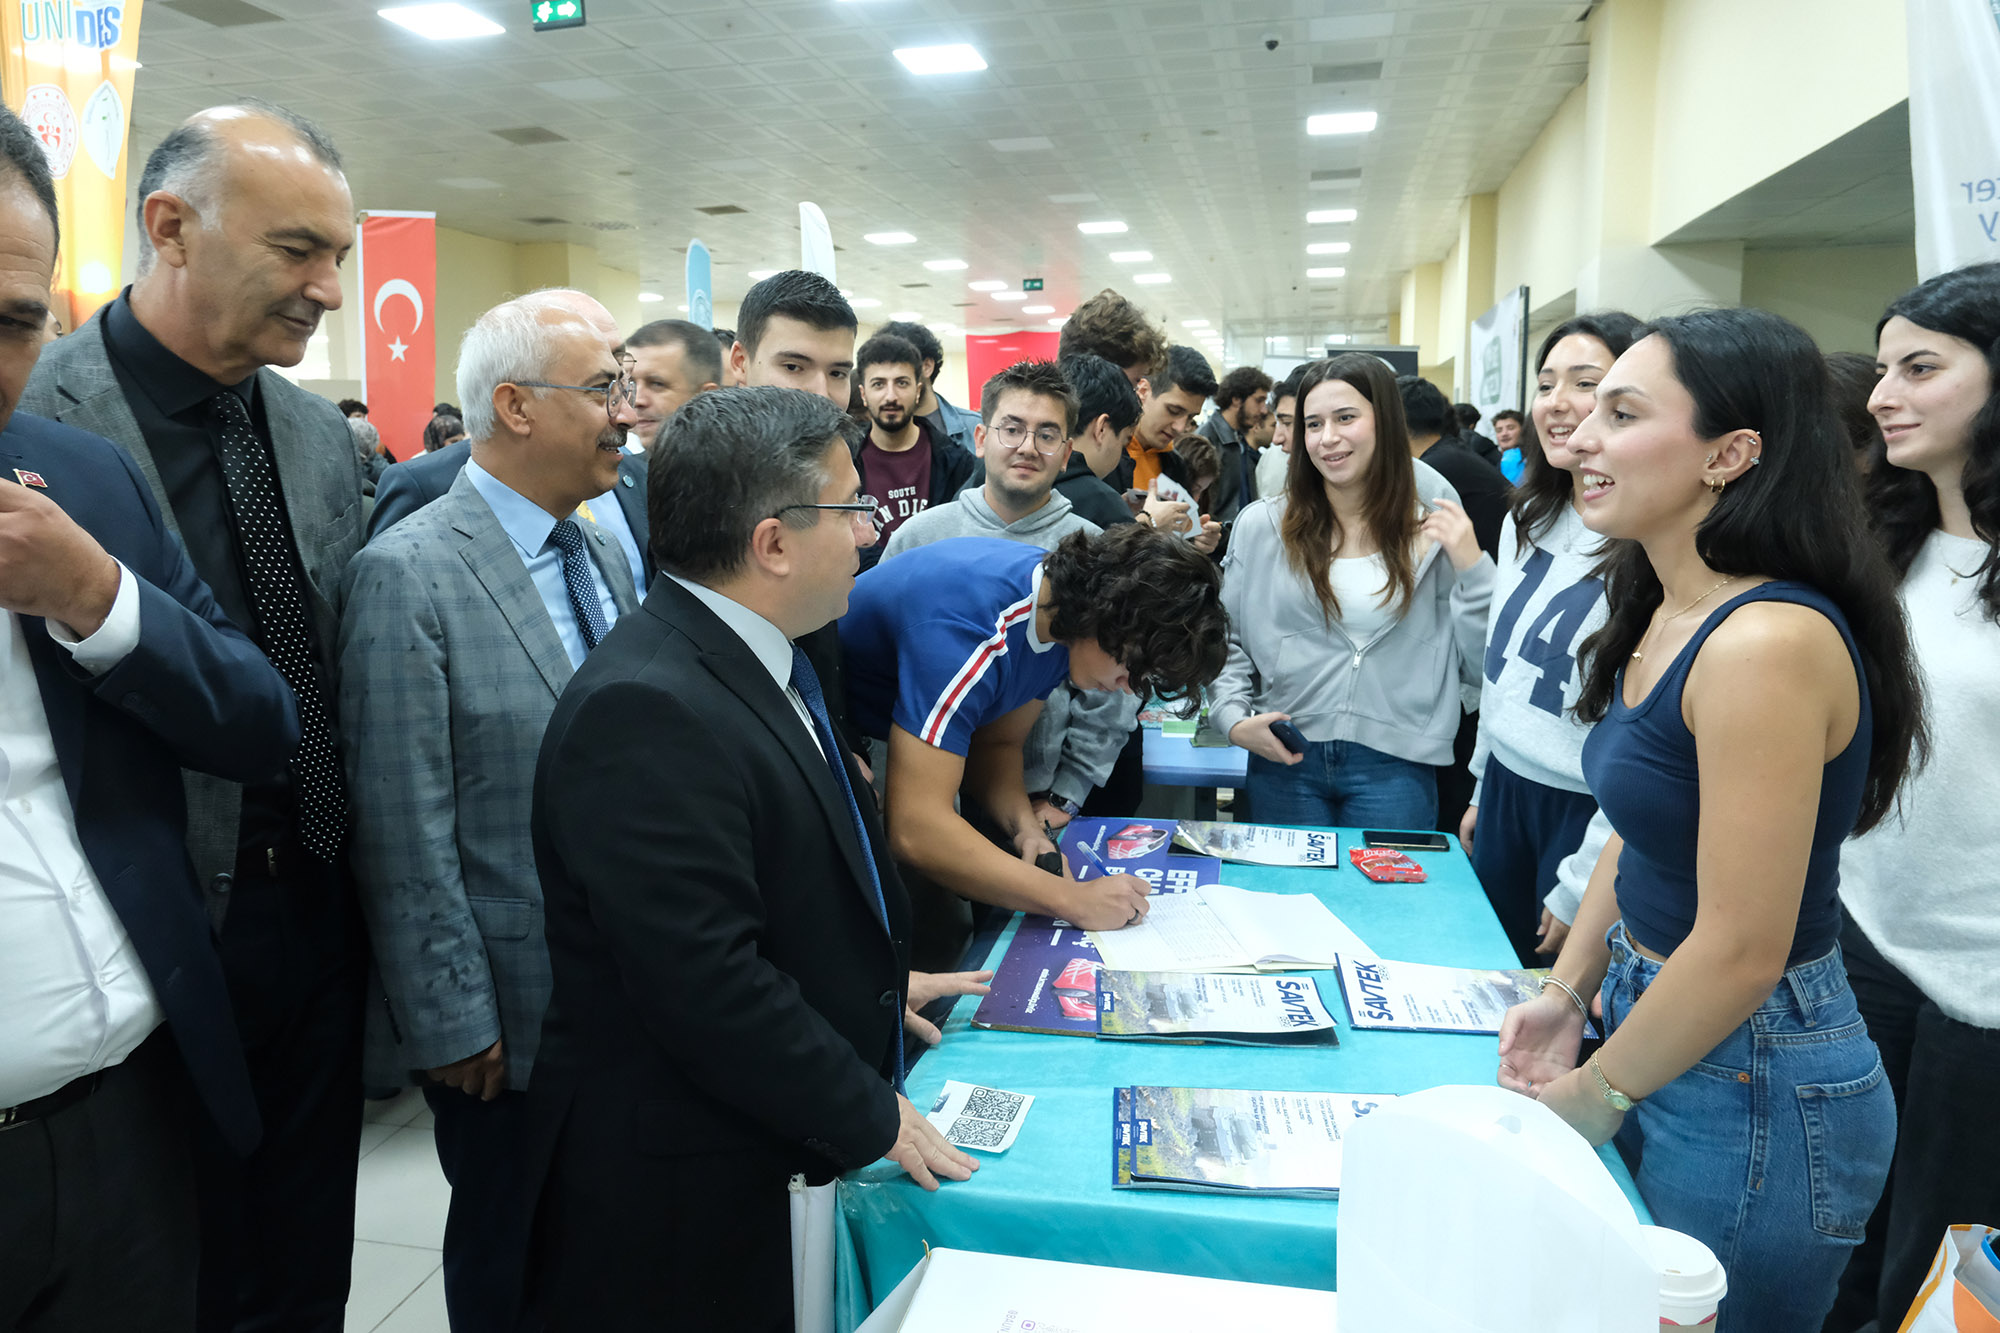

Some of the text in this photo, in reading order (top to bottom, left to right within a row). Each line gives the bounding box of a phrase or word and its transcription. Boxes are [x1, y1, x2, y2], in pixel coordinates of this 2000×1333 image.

[888, 486, 917, 499] SOUTH
[1484, 546, 1606, 718] 14
[1306, 833, 1325, 863] SAVTEK
[1164, 869, 1198, 894] EFF
[1276, 980, 1319, 1027] SAVTEK
[1352, 960, 1394, 1021] SAVTEK
